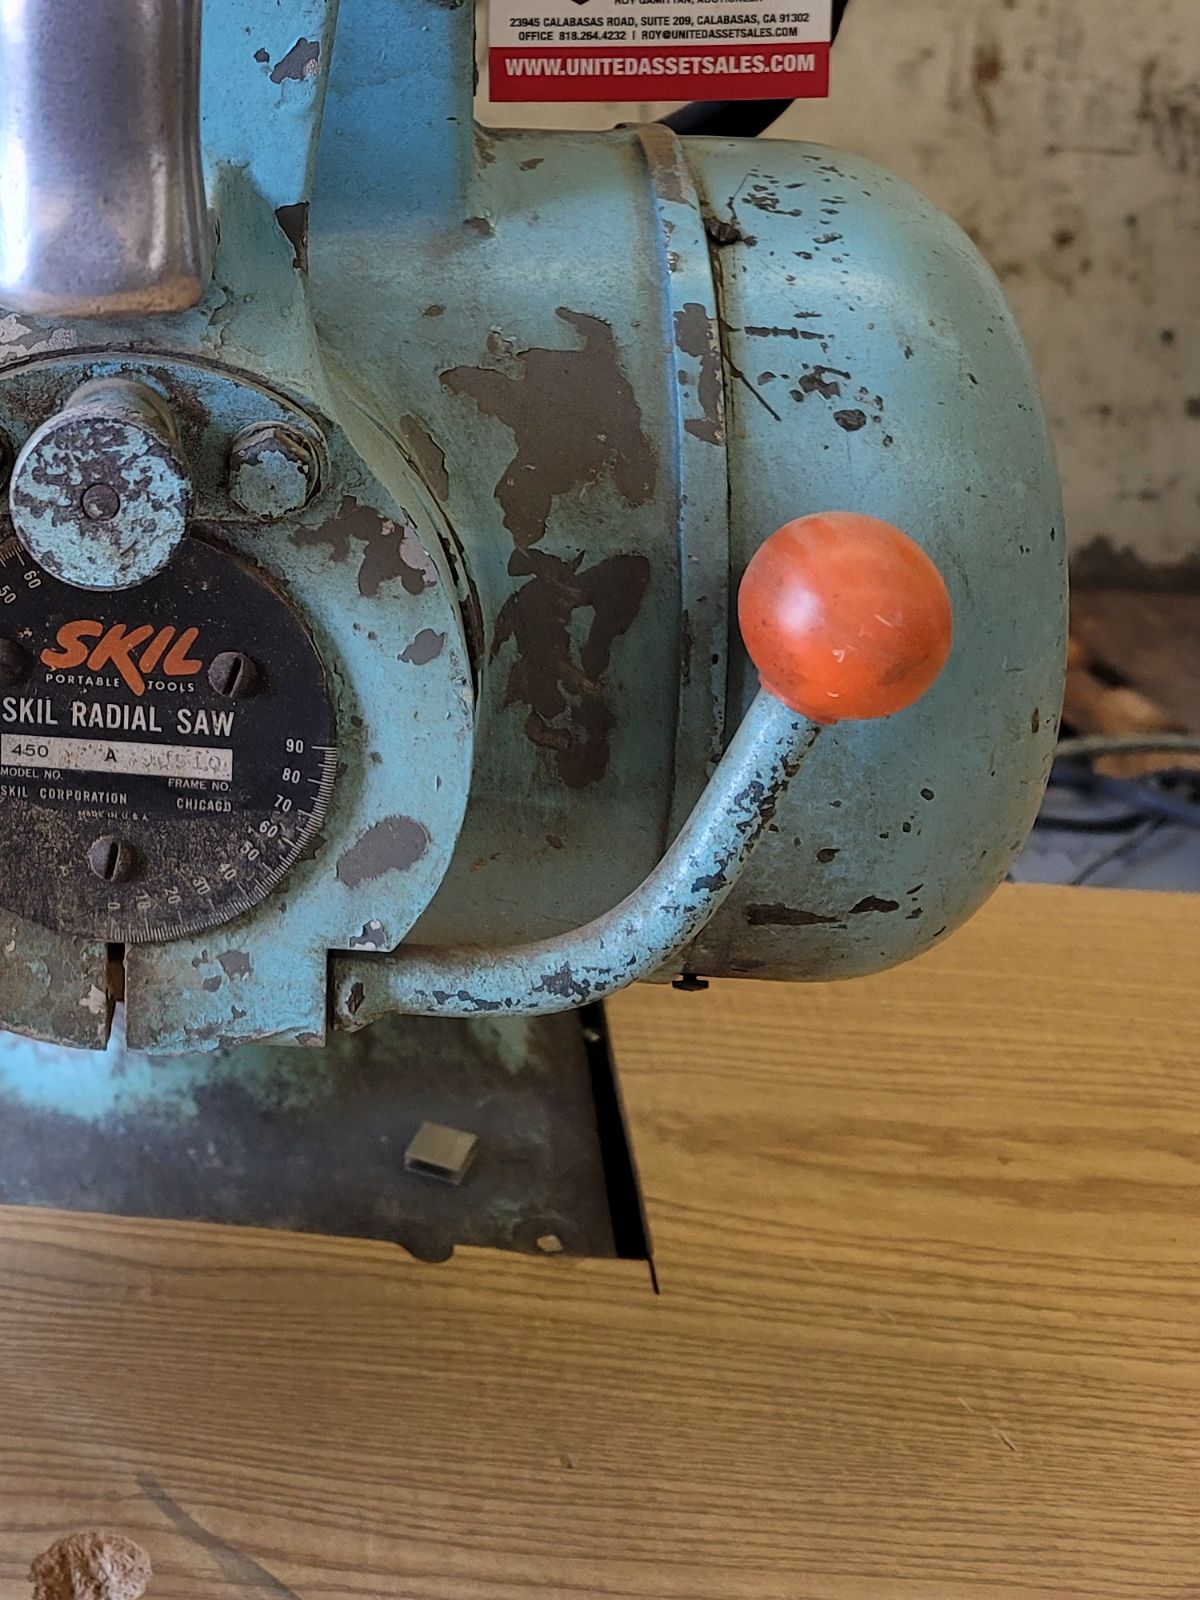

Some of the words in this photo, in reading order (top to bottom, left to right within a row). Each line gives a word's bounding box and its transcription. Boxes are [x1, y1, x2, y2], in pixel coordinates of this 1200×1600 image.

[509, 17, 541, 28] 23945
[543, 17, 604, 27] CALABASAS
[606, 16, 638, 28] ROAD,
[641, 16, 670, 26] SUITE
[672, 15, 694, 27] 209,
[696, 14, 760, 26] CALABASAS,
[763, 13, 777, 24] CA
[779, 12, 810, 24] 91302
[518, 31, 553, 41] OFFICE
[559, 30, 626, 41] 818.264.4232
[641, 27, 798, 40] ROY@UNITEDASSETSALES.COM
[504, 54, 815, 77] WWW.UNITEDASSETSALES.COM
[24, 569, 41, 589] 60
[39, 619, 203, 696] SKIL
[45, 673, 120, 688] PORTABLE
[148, 680, 195, 693] TOOLS
[2, 696, 59, 726] SKIL
[71, 701, 162, 733] RADIAL
[176, 708, 235, 737] SAW
[11, 743, 49, 758] 450
[104, 748, 117, 763] A
[286, 739, 304, 753] 90
[0, 766, 39, 779] MODEL
[43, 769, 64, 781] NO.
[167, 778, 207, 790] FRAME
[211, 780, 232, 792] NO.
[282, 767, 301, 784] 80
[0, 785, 29, 798] SKIL
[39, 787, 128, 805] CORPORATION
[274, 794, 292, 812] 70
[259, 820, 279, 838] 60
[240, 840, 260, 861] 50
[218, 861, 236, 881] 40
[165, 886, 182, 904] 20
[193, 876, 211, 895] 30
